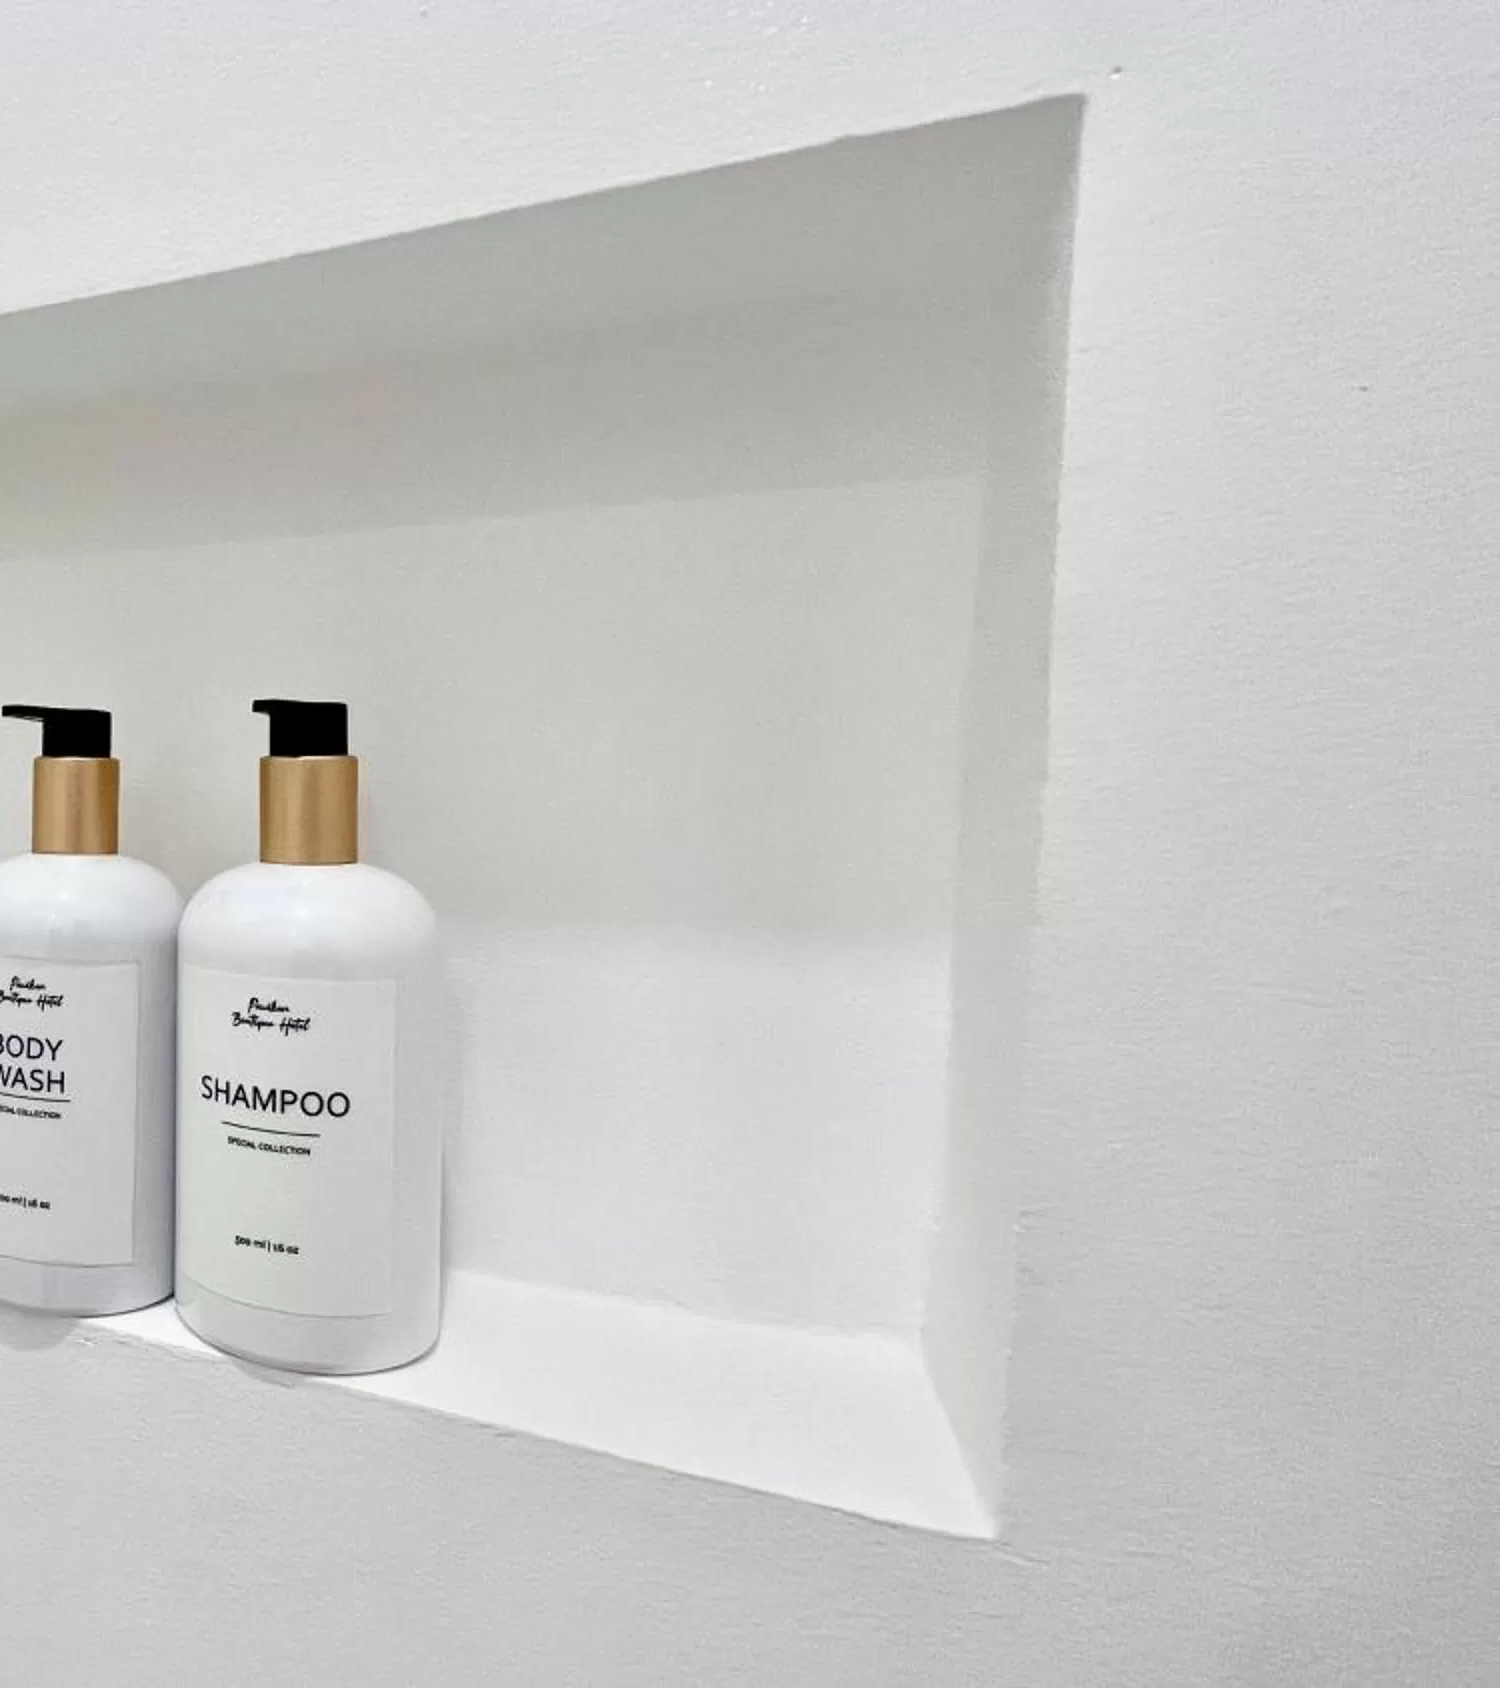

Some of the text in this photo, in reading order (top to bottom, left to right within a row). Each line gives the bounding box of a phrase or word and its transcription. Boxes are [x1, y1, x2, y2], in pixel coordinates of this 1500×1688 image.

[279, 1017, 311, 1036] Hotel
[201, 1075, 350, 1117] SHAMPOO
[17, 1107, 61, 1119] COLLECTION
[228, 1136, 311, 1156] SPECIAL COLLECTION
[235, 1235, 251, 1246] 500
[286, 1246, 299, 1255] oz
